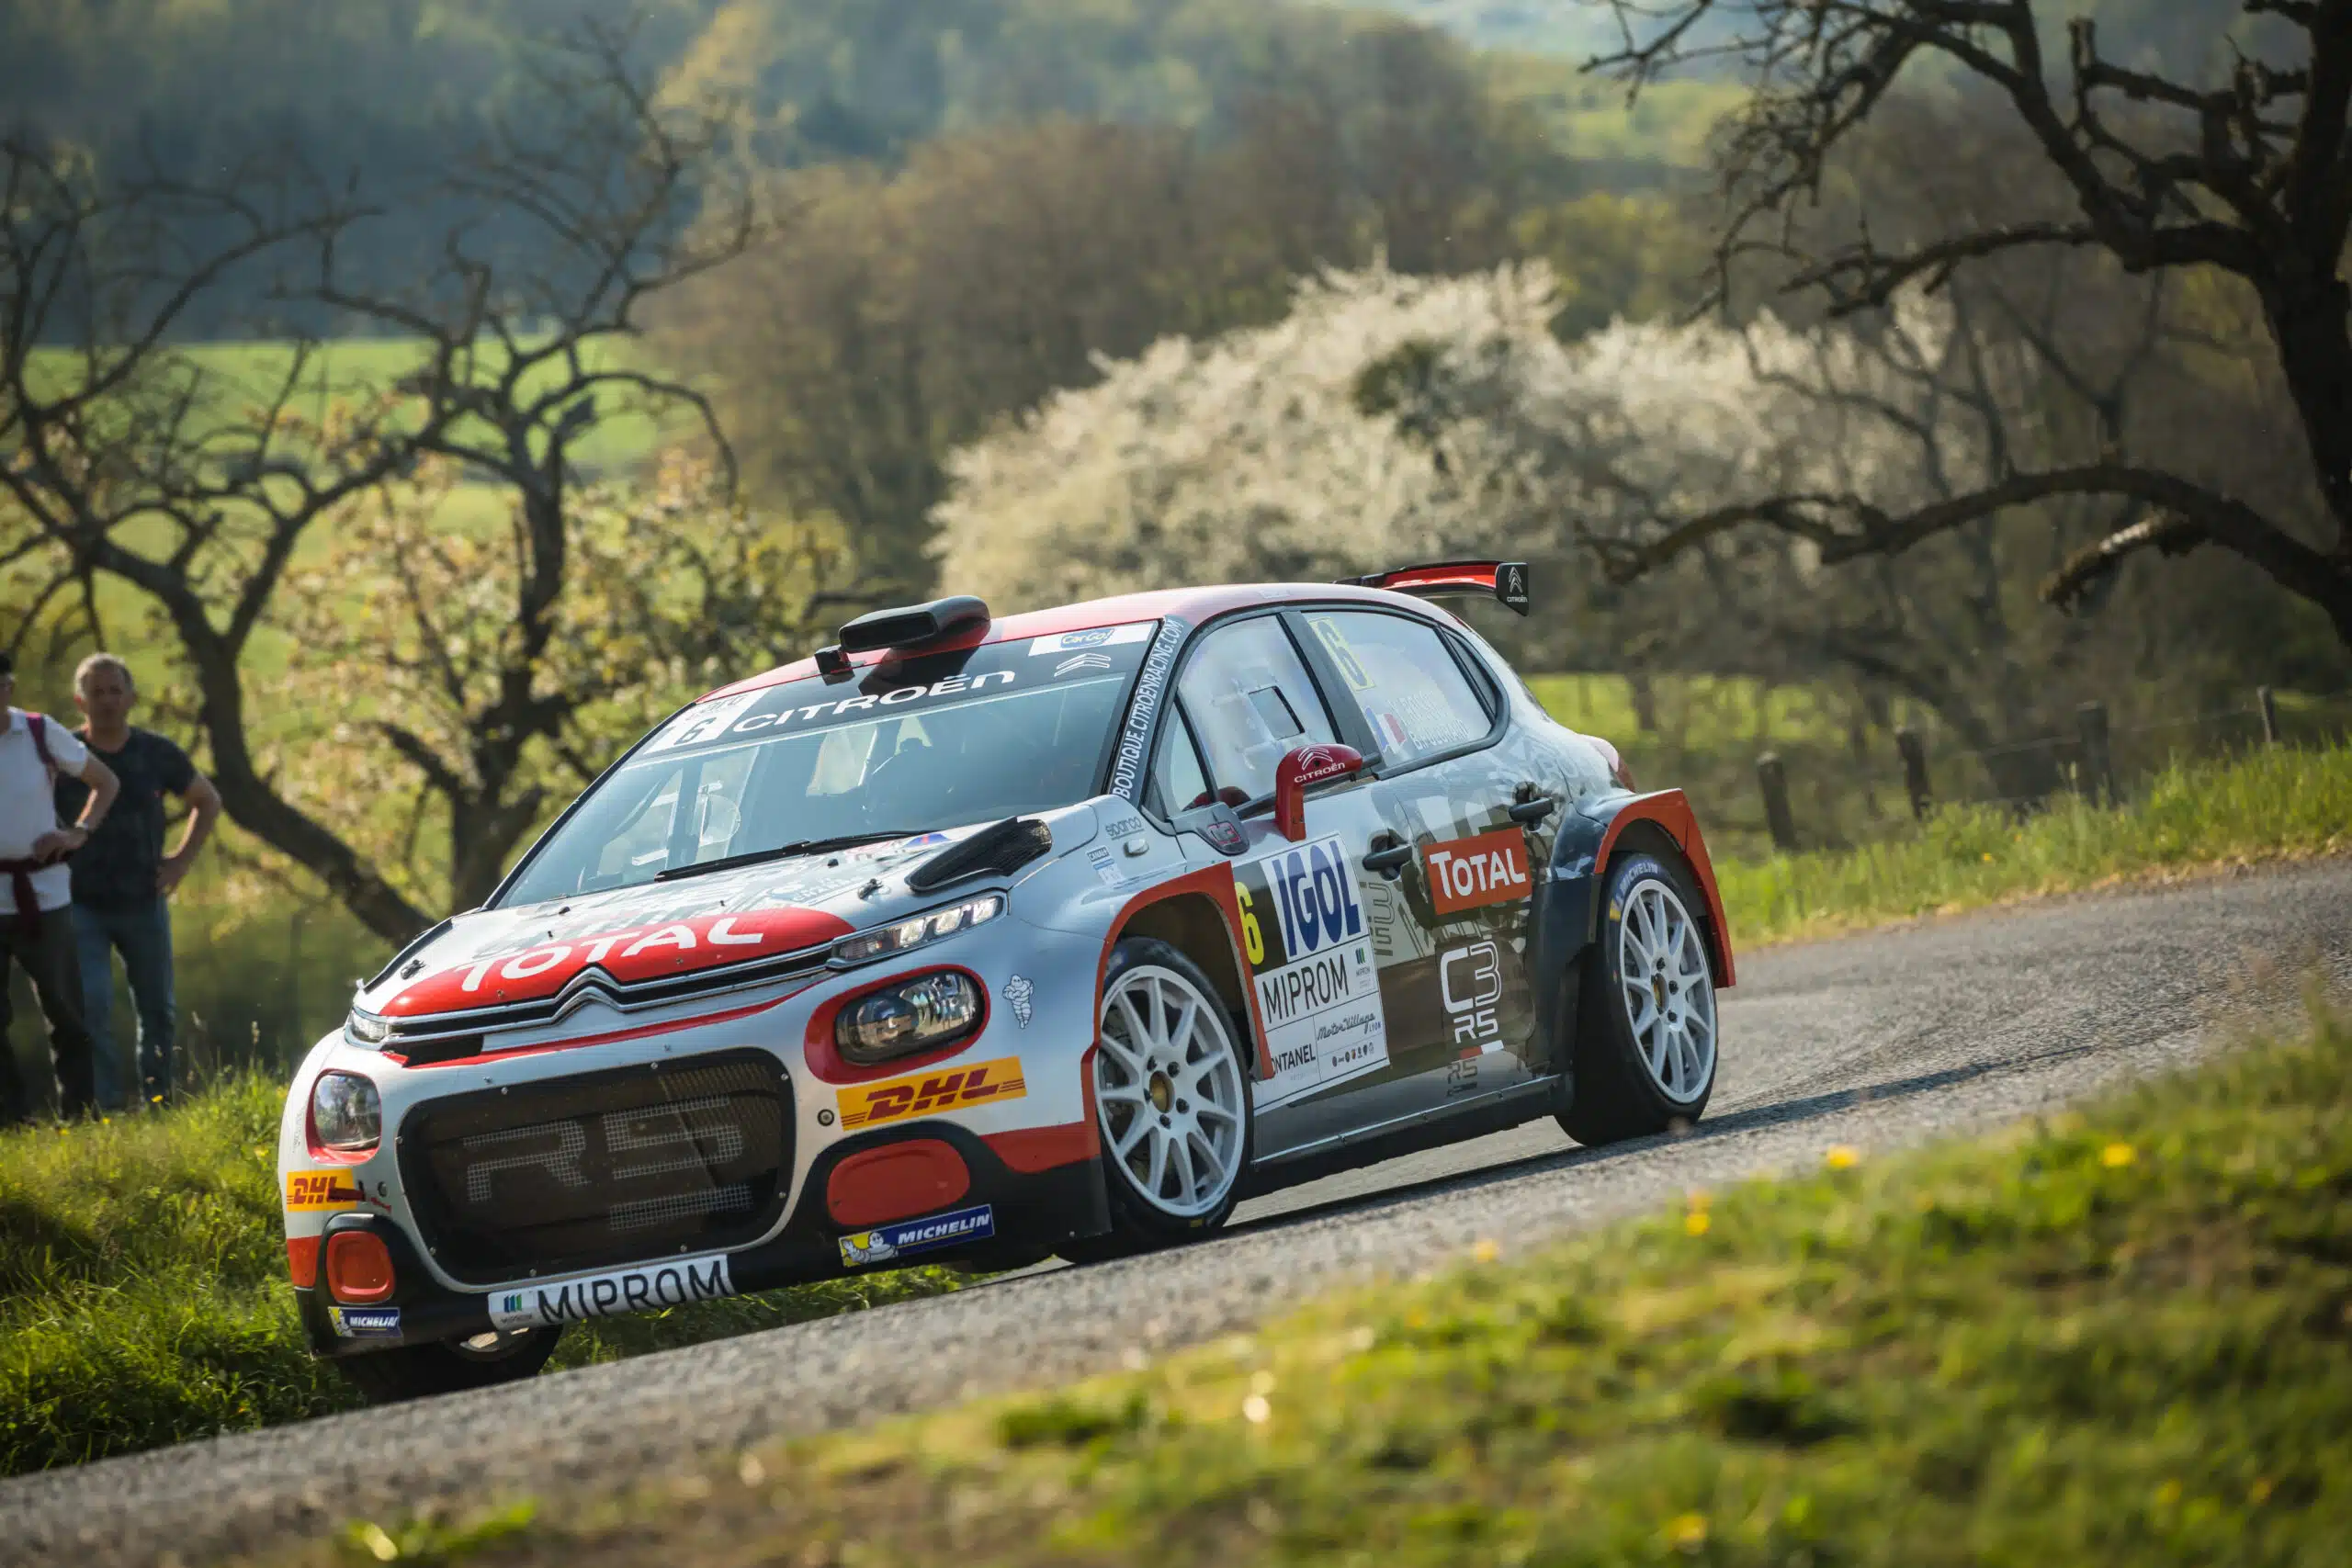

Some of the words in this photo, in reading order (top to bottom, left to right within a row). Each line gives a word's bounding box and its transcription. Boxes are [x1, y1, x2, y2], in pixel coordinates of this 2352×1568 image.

[1317, 621, 1368, 687] 6
[673, 717, 717, 746] 6
[733, 671, 1015, 732] CITROËN
[1113, 619, 1184, 799] BOUTIQUE.CITROENRACING.COM
[1294, 761, 1345, 783] CITROËN
[1272, 840, 1361, 956] IGOL
[1430, 848, 1526, 899] TOTAL
[1235, 882, 1264, 964] 6
[454, 918, 763, 992] TOTAL
[1441, 941, 1502, 1013] C3
[1262, 953, 1349, 1023] MIPROM
[1453, 1008, 1498, 1043] R5
[867, 1068, 999, 1121] DHL
[898, 1213, 990, 1246] MICHELIN
[349, 1314, 398, 1328] MICHELIN
[537, 1260, 732, 1323] MIPROM
